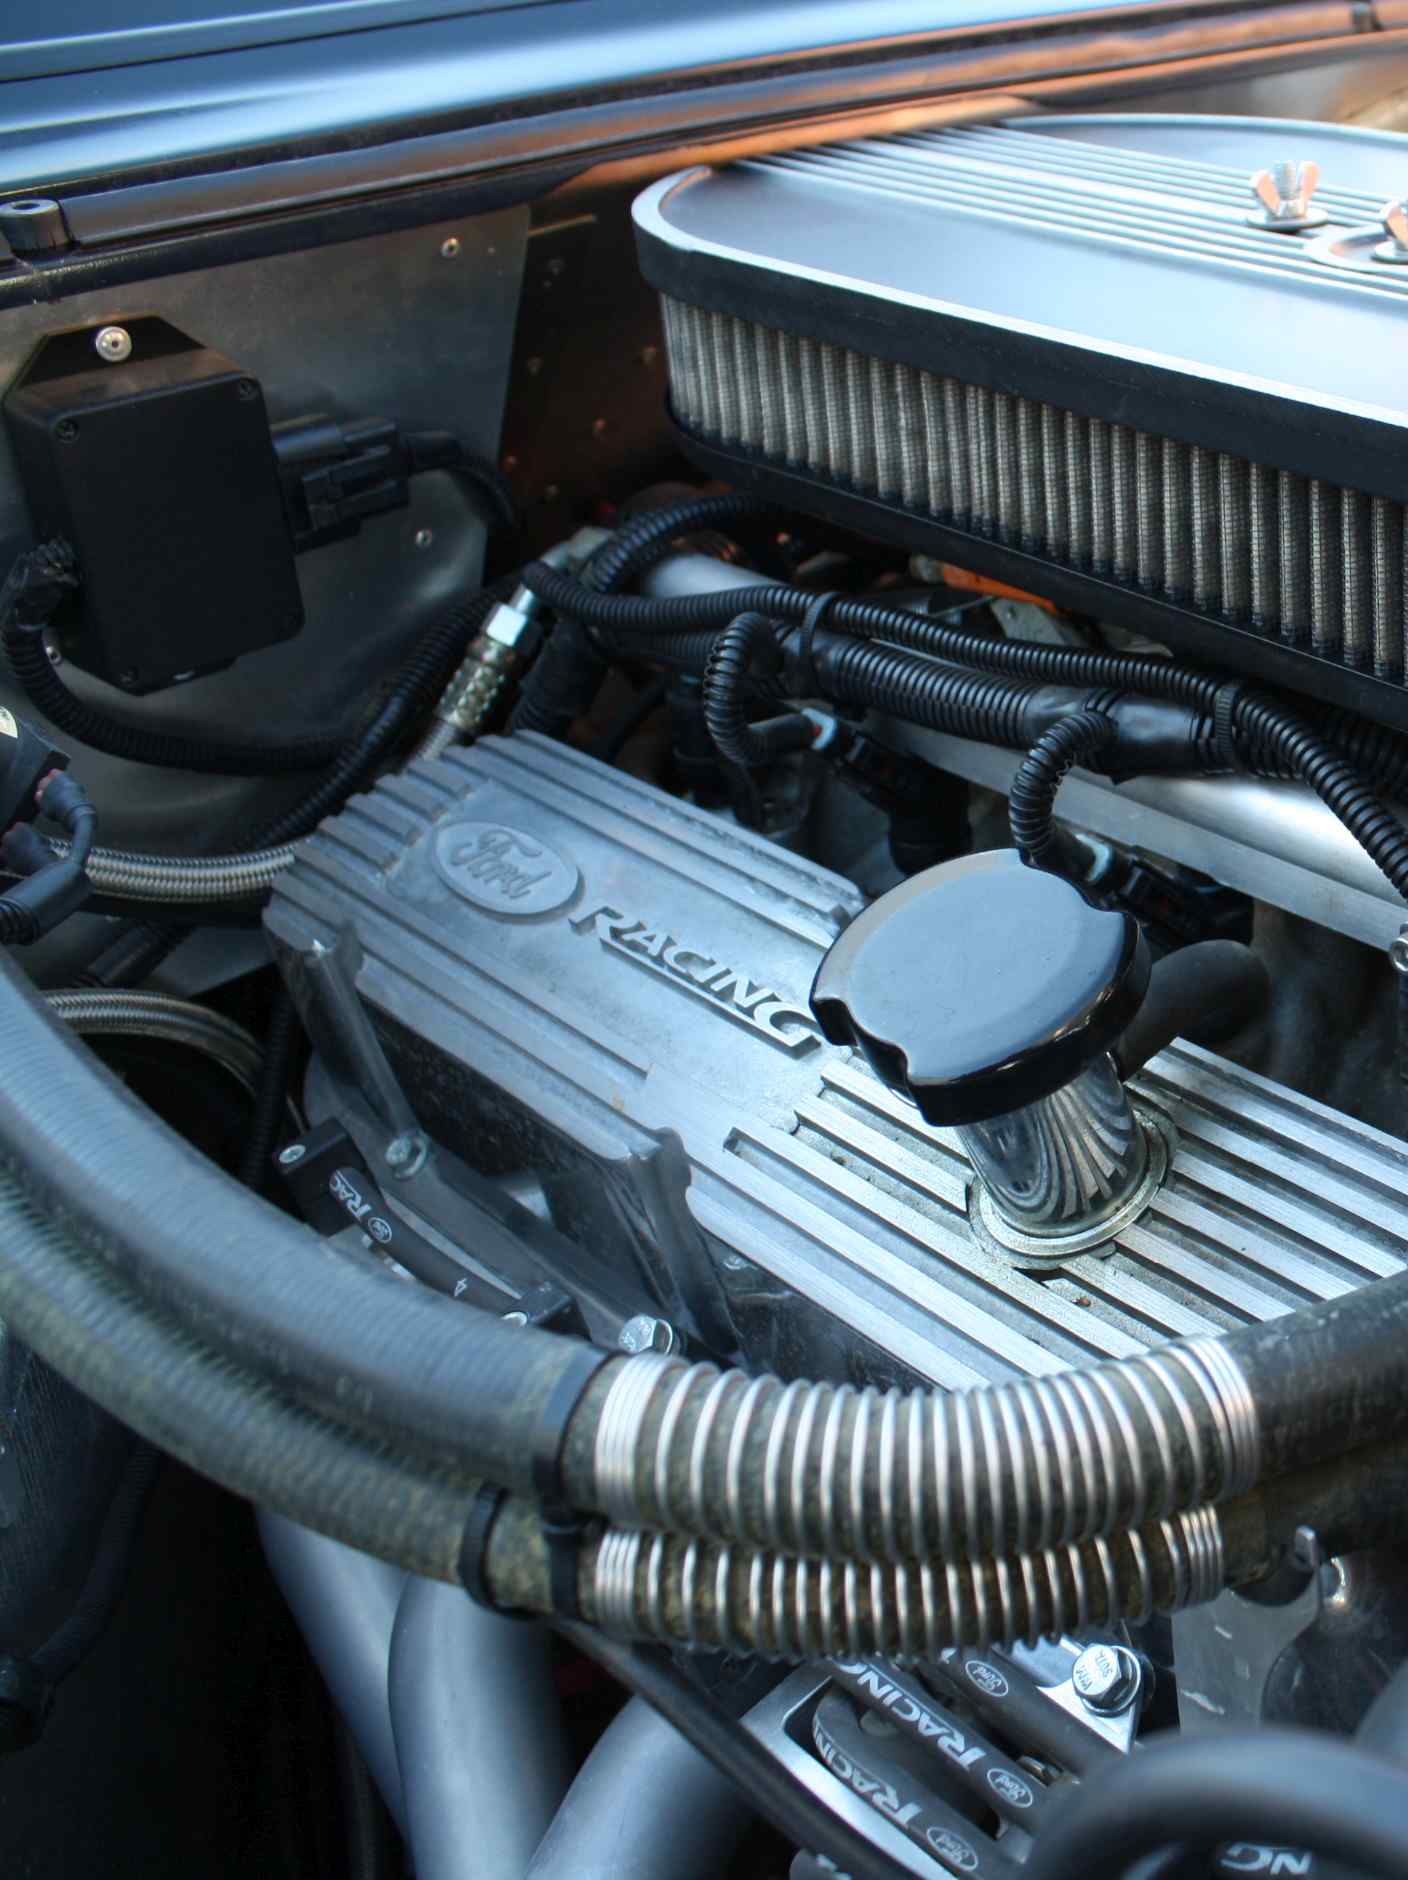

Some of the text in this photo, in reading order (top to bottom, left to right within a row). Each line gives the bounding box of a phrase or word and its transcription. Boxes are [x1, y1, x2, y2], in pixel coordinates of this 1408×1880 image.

[447, 827, 824, 1060] Ford RACING
[329, 1171, 467, 1297] 4 RAC
[814, 1720, 923, 1828] RACIN
